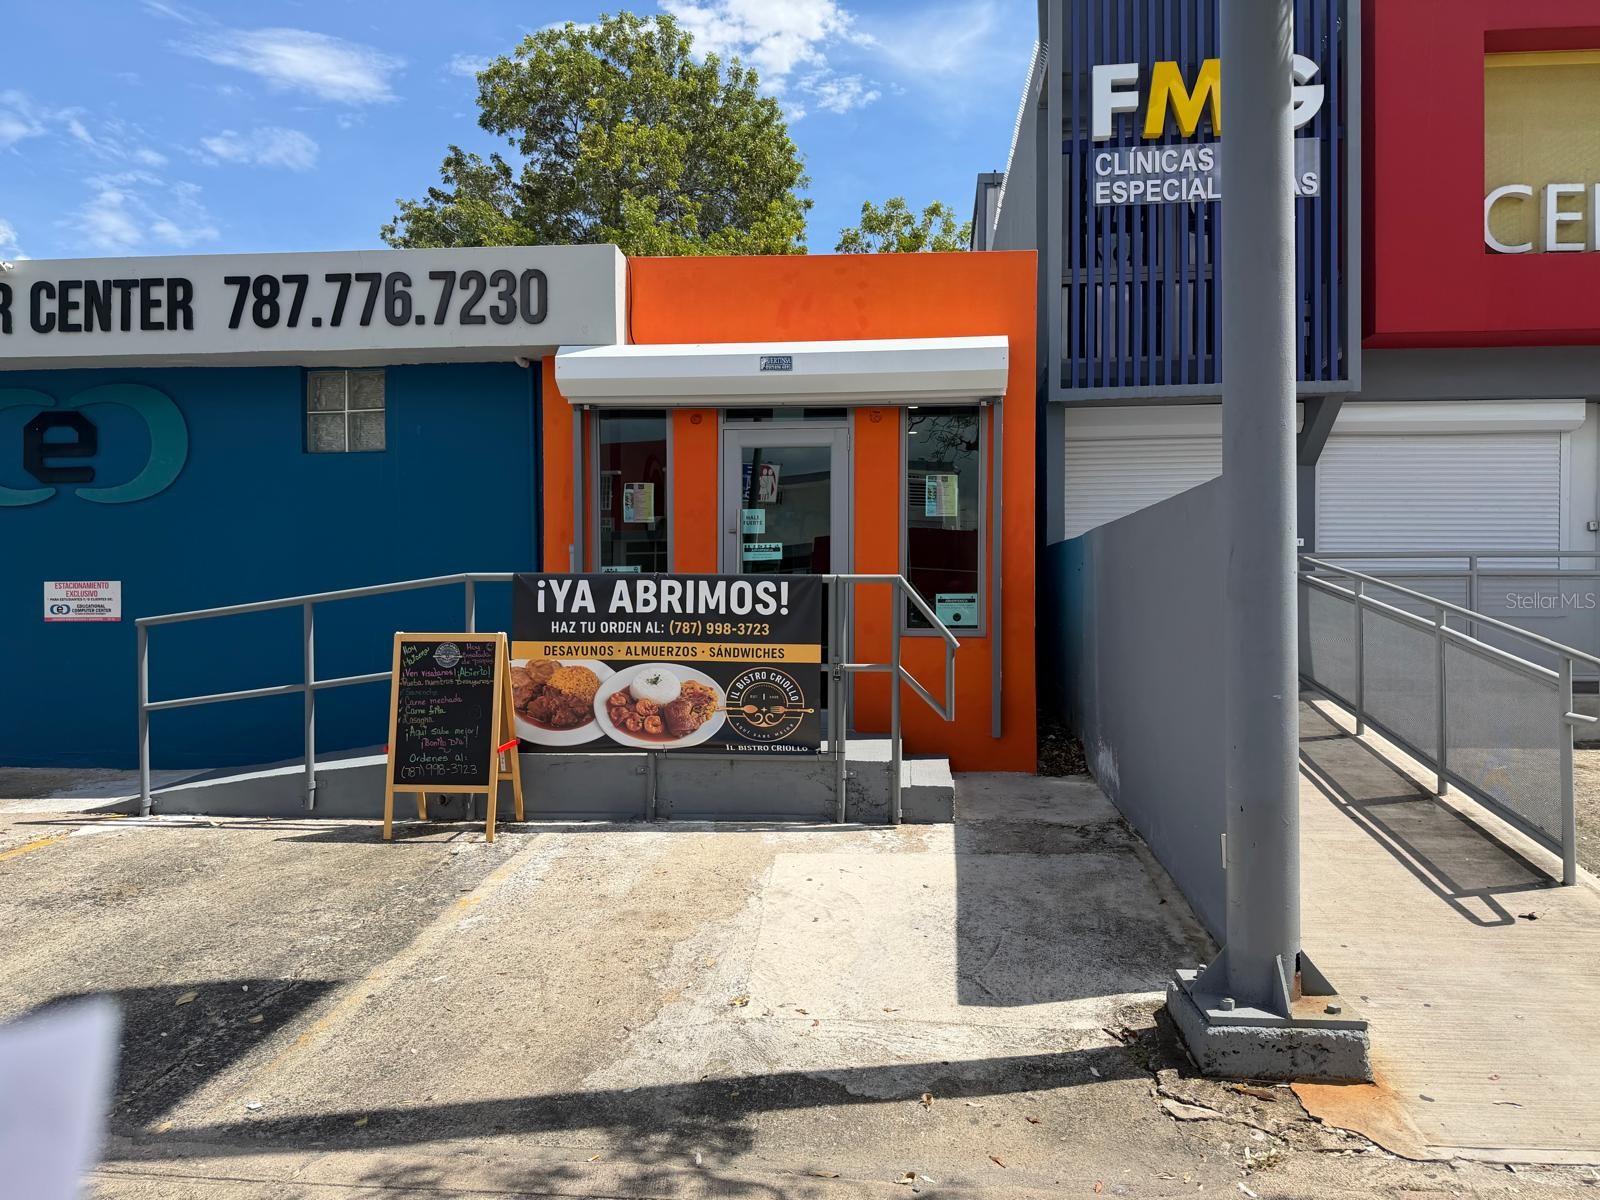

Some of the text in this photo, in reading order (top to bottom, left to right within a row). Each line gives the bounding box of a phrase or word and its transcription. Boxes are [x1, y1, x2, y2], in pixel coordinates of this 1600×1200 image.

[1095, 147, 1214, 176] CLÍNICAS
[1484, 183, 1600, 254] CE
[30, 278, 194, 334] CENTER
[224, 268, 548, 330] 787.776.7230
[537, 579, 789, 616] ¡YA ABRIMOS!
[551, 620, 770, 637] HAZ TU ORDEN AL: (787) 998-3723
[543, 644, 785, 660] DESAYUNOS ALMUERZOS SÁNDWICHES
[736, 671, 767, 690] BISTRO
[769, 672, 800, 702] CRIOLLO
[738, 744, 769, 752] BISTRO
